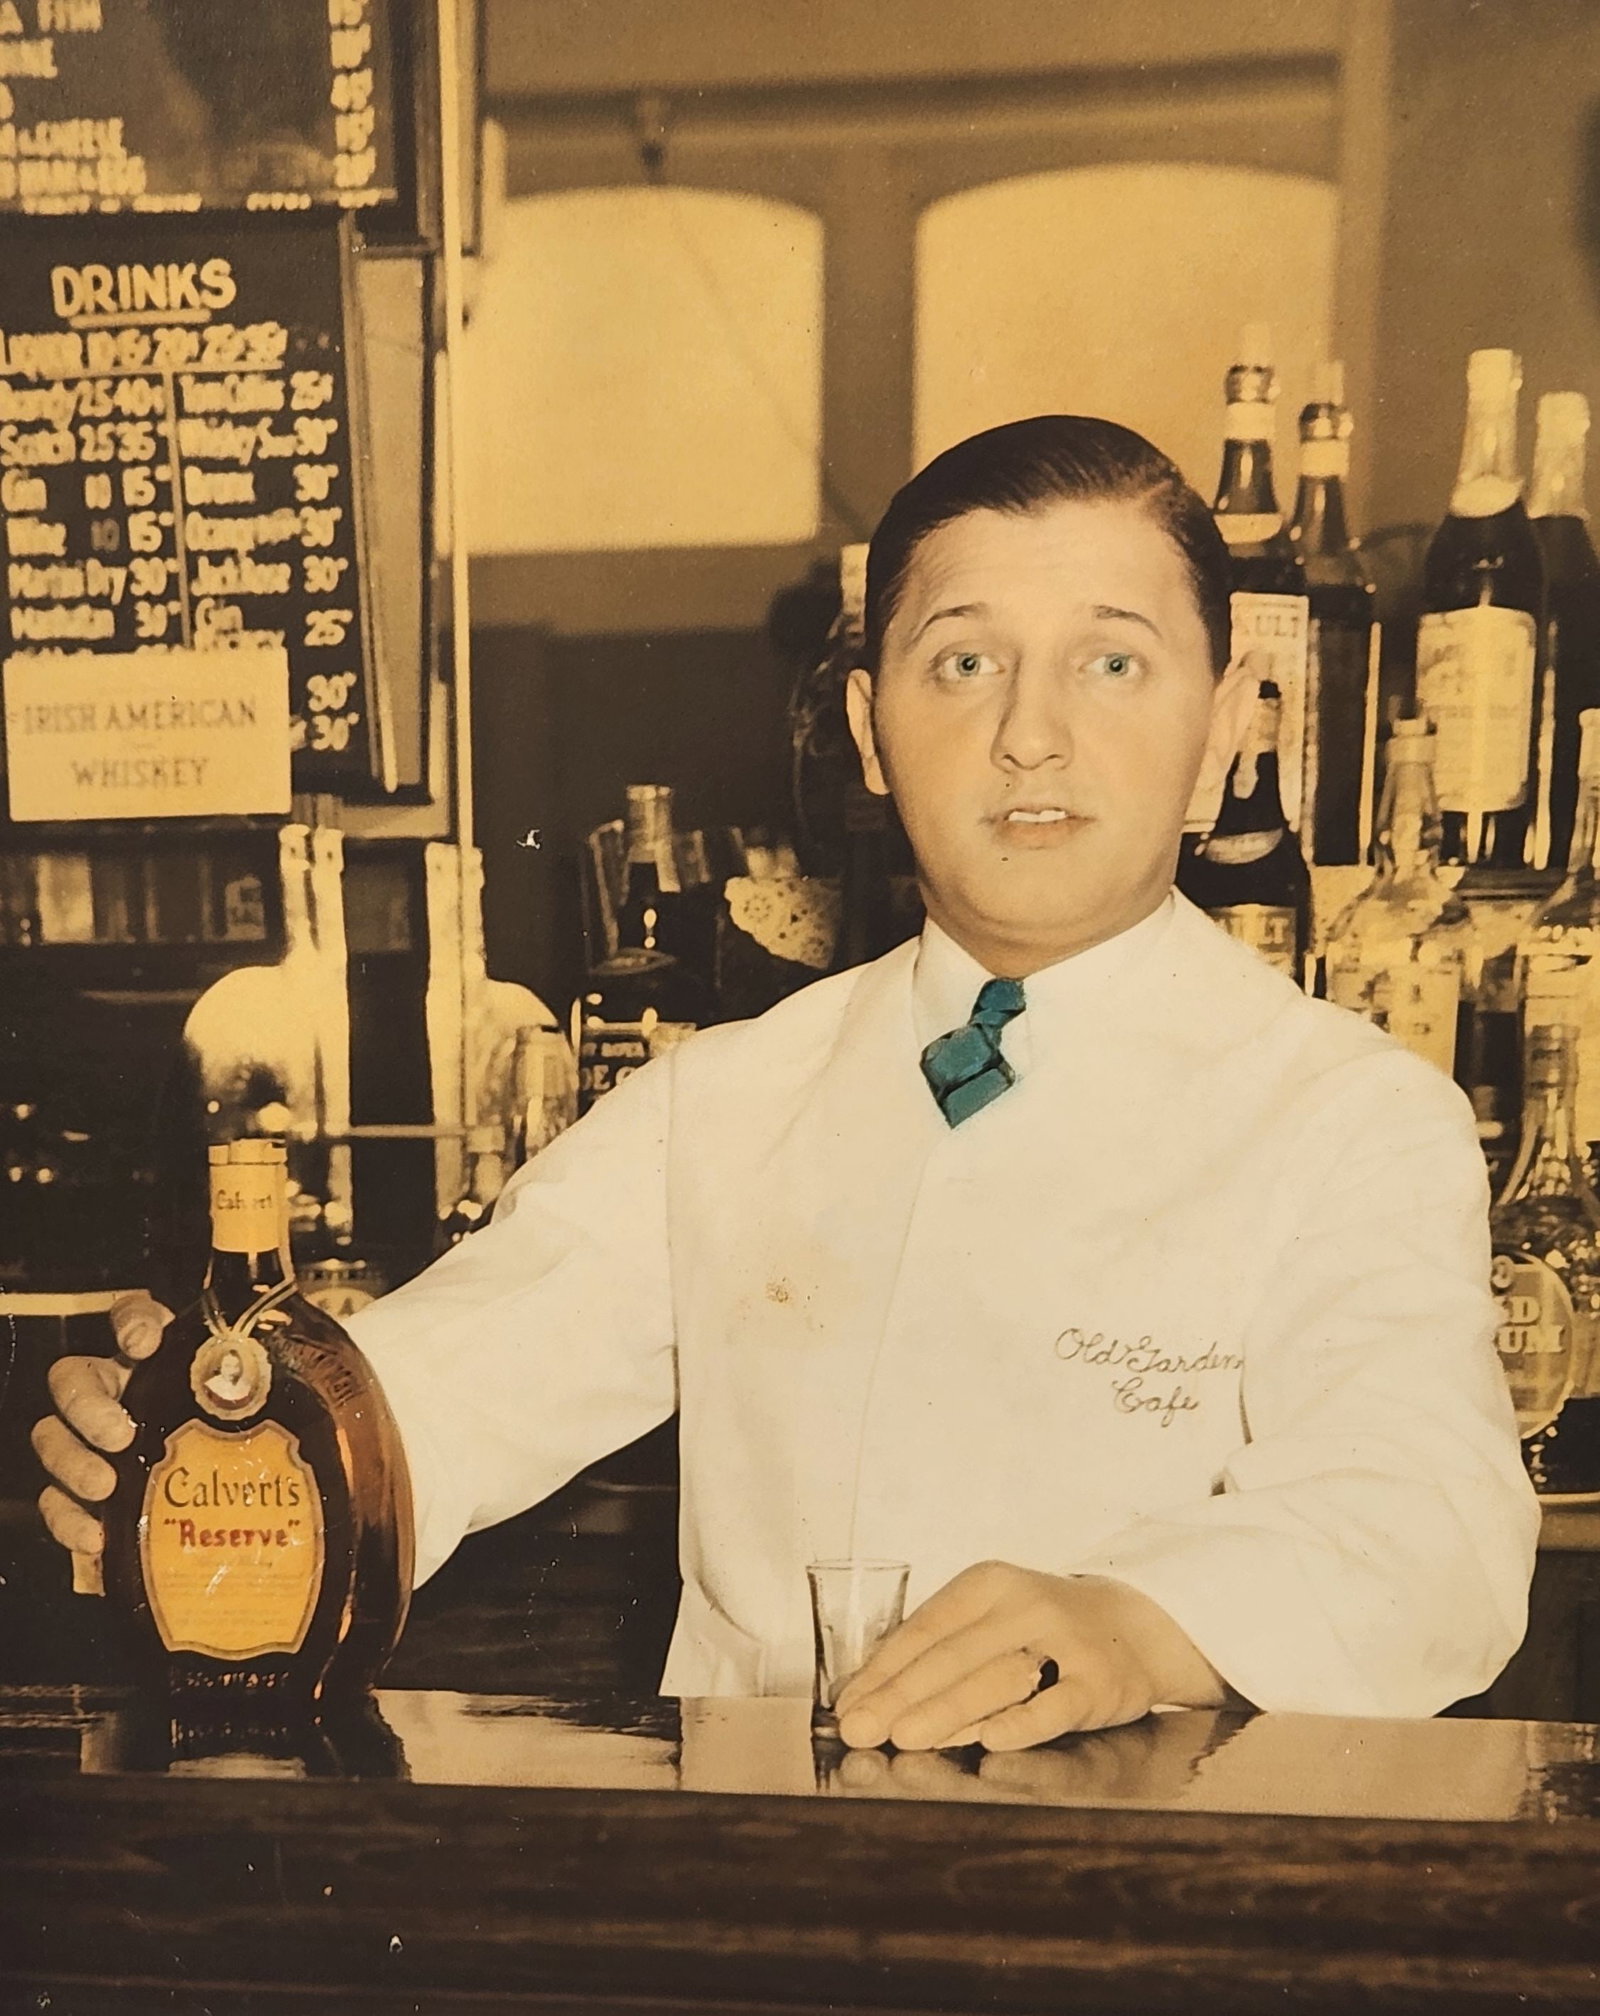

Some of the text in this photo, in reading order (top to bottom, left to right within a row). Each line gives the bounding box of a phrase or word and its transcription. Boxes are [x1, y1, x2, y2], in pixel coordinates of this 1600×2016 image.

[51, 258, 236, 317] DRINKS
[24, 696, 256, 735] IRISH AMERICAN
[71, 757, 211, 788] WHISKEY
[1055, 1327, 1244, 1374] Old Garden
[1111, 1376, 1199, 1428] Cafe
[164, 1466, 300, 1508] Calvert's
